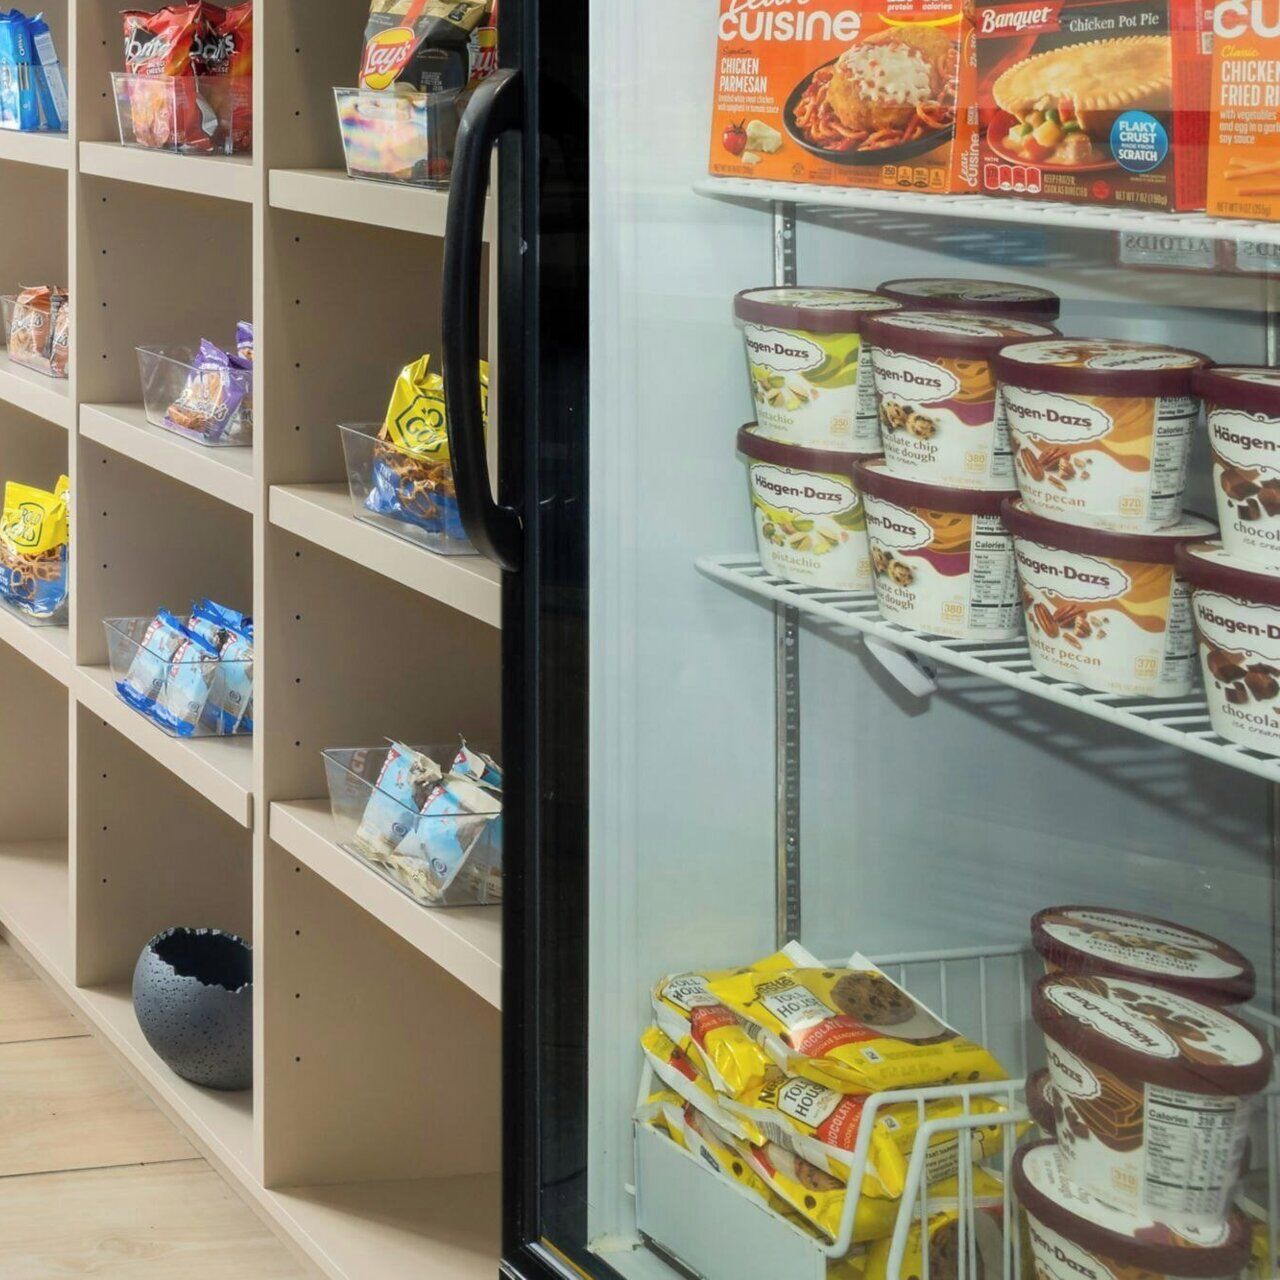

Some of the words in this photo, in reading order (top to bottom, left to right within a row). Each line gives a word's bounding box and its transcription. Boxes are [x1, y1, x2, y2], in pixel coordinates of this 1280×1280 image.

[887, 1, 914, 13] protein
[921, 1, 953, 11] calories
[981, 6, 1053, 33] Banquet
[1069, 18, 1115, 32] Chicken
[1118, 14, 1138, 29] Pot
[1140, 12, 1160, 26] Pie
[364, 41, 411, 76] Lay's
[720, 57, 760, 75] CHICKEN
[719, 76, 768, 94] PARMESAN
[1220, 84, 1259, 106] FRIED
[1236, 111, 1279, 123] vegetables
[1119, 121, 1157, 134] FLAKY
[1219, 122, 1235, 132] and
[1237, 123, 1253, 135] egg
[1119, 132, 1158, 144] CRUST
[1219, 135, 1233, 145] soy
[1234, 135, 1256, 145] sauce
[1118, 148, 1158, 162] SCRATCH
[1157, 426, 1184, 435] Calories
[913, 438, 939, 454] chip
[901, 447, 936, 465] dough
[966, 453, 985, 464] 380
[755, 474, 843, 503] Häagen-Dazs
[1045, 490, 1086, 508] pecan
[1122, 497, 1141, 508] 370
[975, 540, 1005, 549] Calories
[771, 550, 822, 570] pistachio
[894, 587, 917, 601] chip
[944, 604, 963, 615] 380
[1059, 648, 1102, 667] pecan
[1136, 658, 1156, 669] 370
[775, 985, 808, 1003] TOLL
[1063, 990, 1161, 1048] Häagen-Dazs
[1148, 1108, 1189, 1125] Calories
